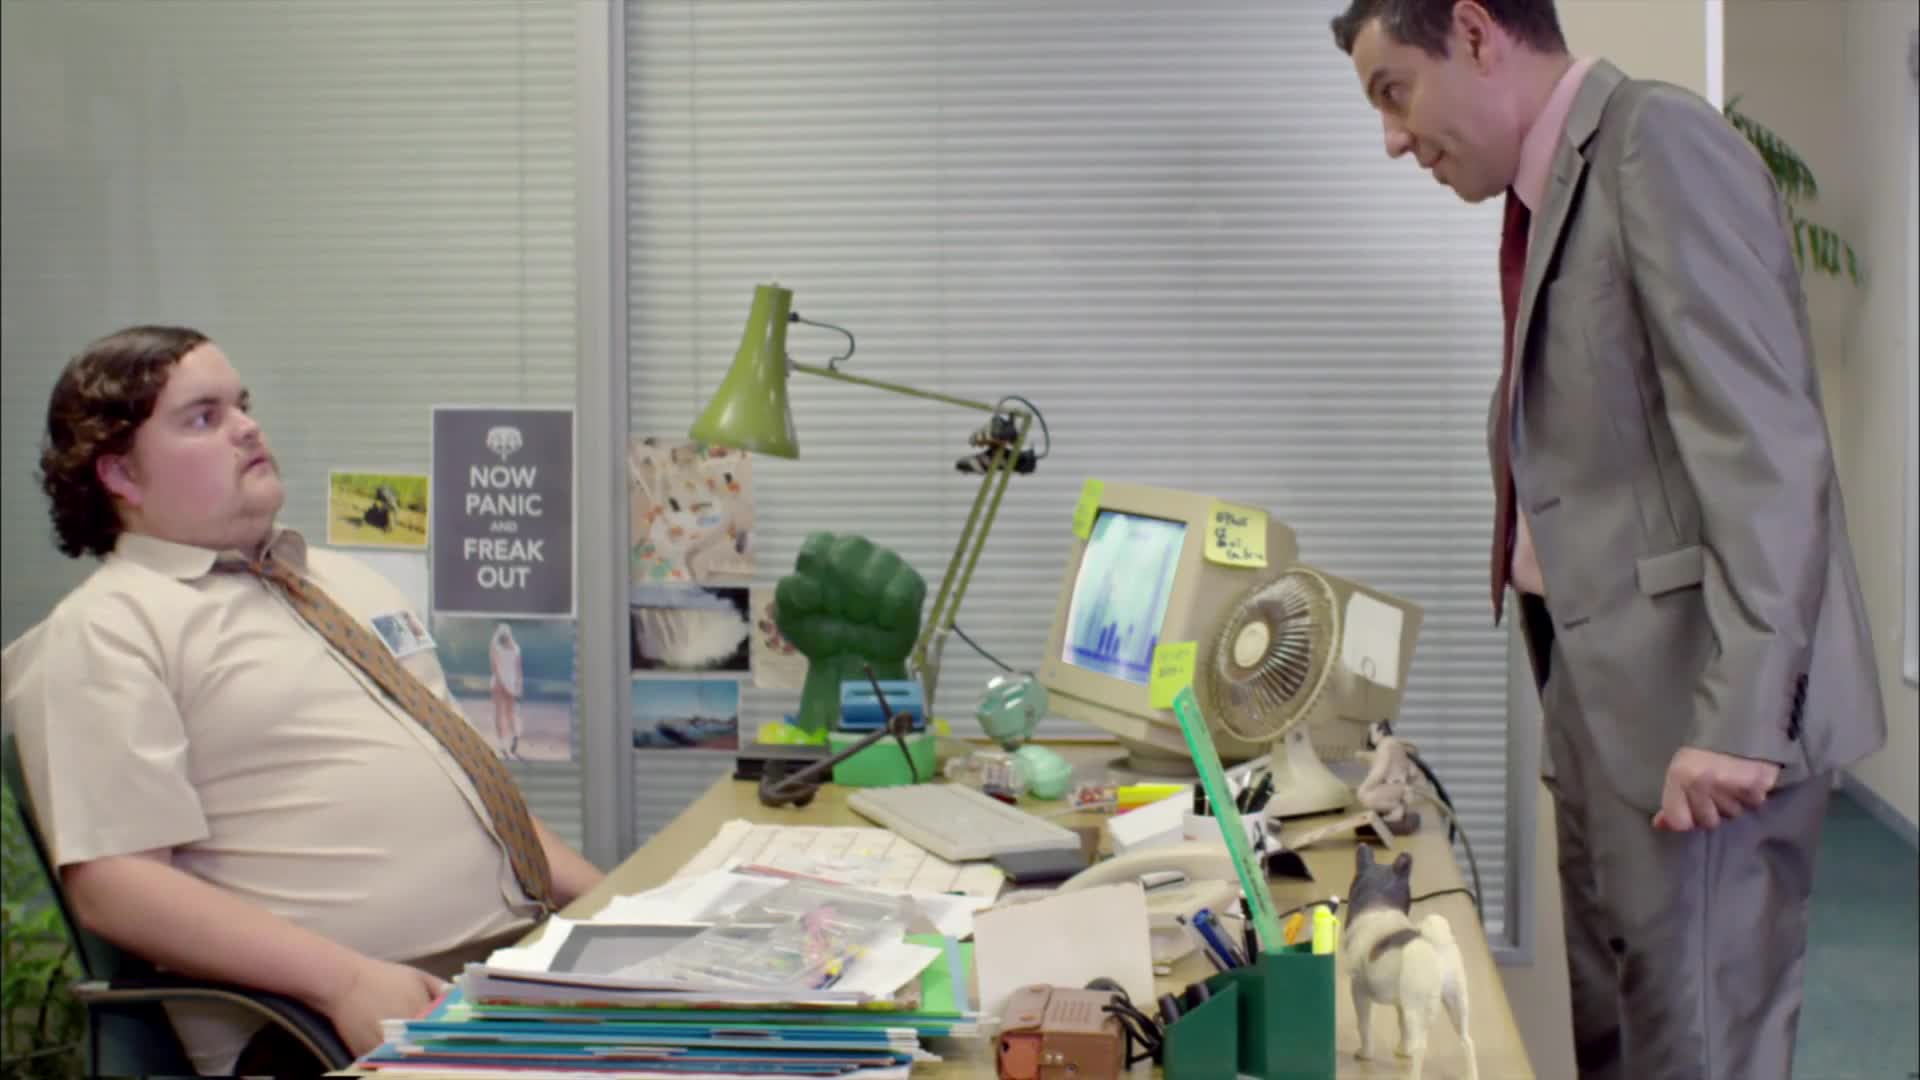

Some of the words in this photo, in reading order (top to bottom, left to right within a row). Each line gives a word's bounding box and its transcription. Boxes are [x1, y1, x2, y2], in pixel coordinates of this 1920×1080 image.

[469, 465, 537, 489] NOW
[465, 493, 543, 516] PANIC
[490, 521, 518, 533] AND
[463, 538, 545, 561] FREAK
[477, 566, 531, 588] OUT
